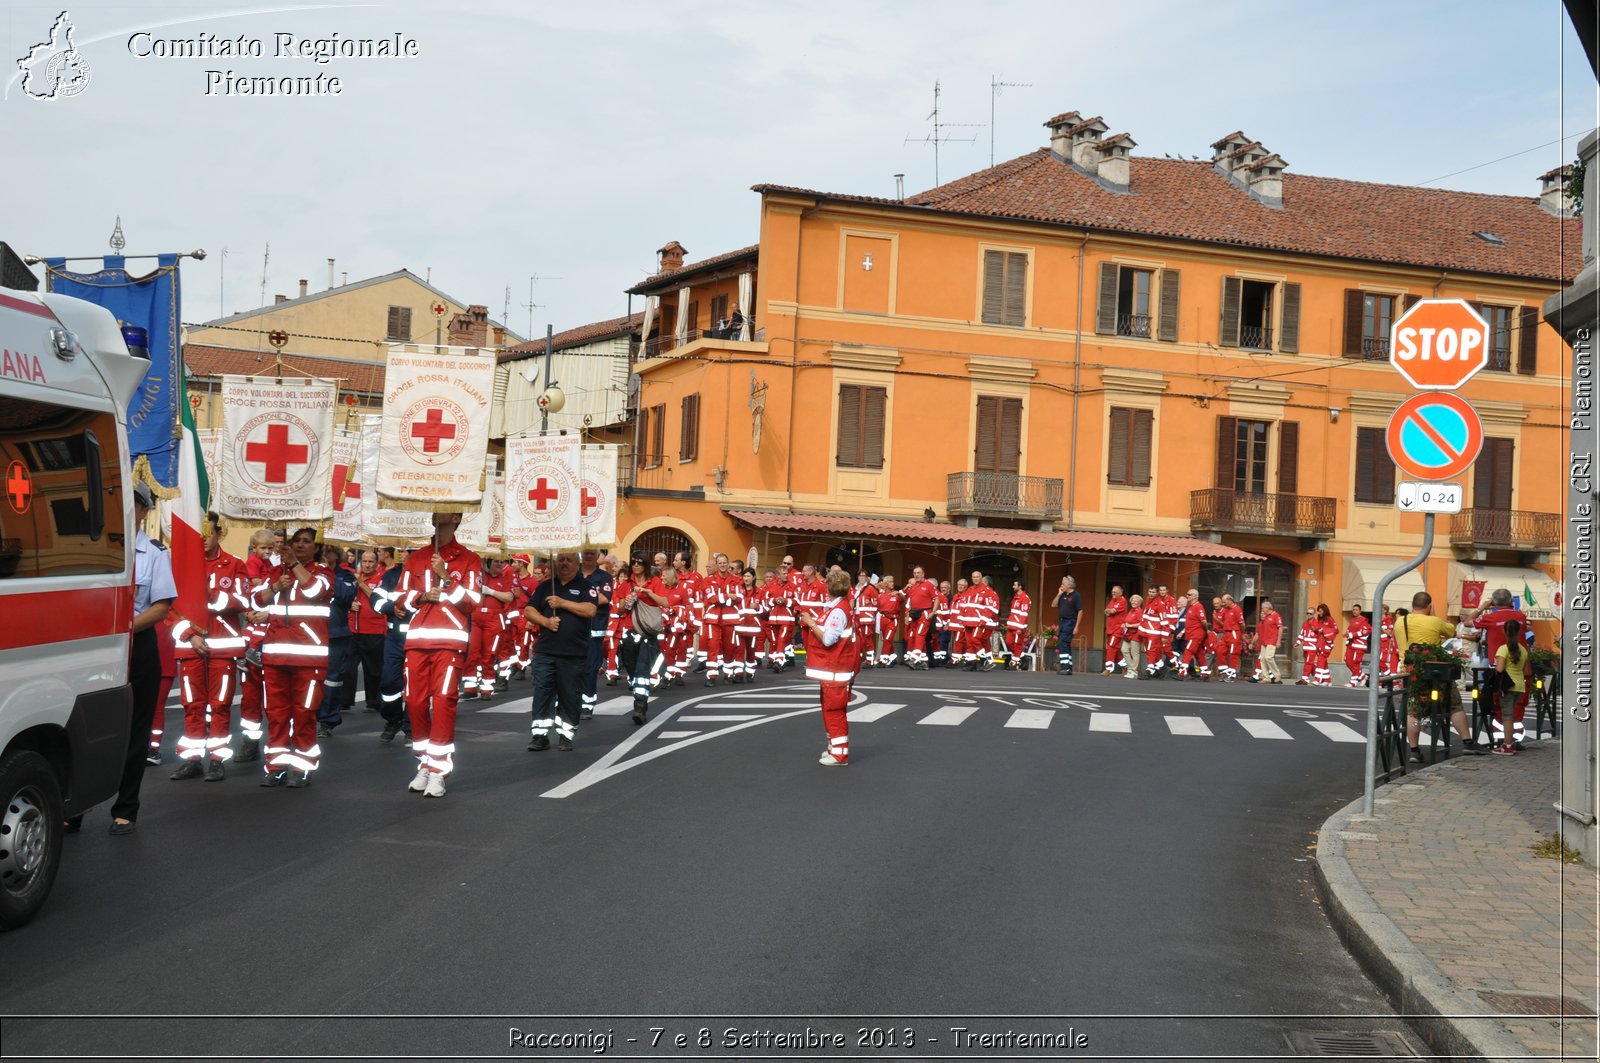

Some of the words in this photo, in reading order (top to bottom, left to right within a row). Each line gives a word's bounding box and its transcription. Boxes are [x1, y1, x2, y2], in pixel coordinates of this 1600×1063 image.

[1398, 327, 1482, 361] STOP
[0, 349, 47, 384] ANA
[446, 361, 456, 369] DEL
[228, 388, 248, 396] CORPO
[251, 389, 283, 399] VOLONTARI
[286, 391, 297, 399] DEL
[300, 391, 330, 399] SOCCORSO
[387, 380, 415, 404] CROCE
[417, 374, 449, 384] ROSSA
[453, 379, 487, 408] ITALIANA
[223, 397, 256, 408] CROCE
[259, 400, 291, 409] ROSSA
[294, 400, 334, 409] ITALIANA
[525, 454, 552, 467] ROSSA
[553, 456, 580, 489] ITALIANA
[392, 472, 454, 482] DELEGAZIONE
[458, 475, 468, 483] DI
[400, 486, 454, 497] PAESANA
[227, 495, 271, 505] COMITATO
[275, 498, 310, 506] LOCALE
[1422, 492, 1455, 504] 0-24
[241, 507, 309, 518] RACCONIGI
